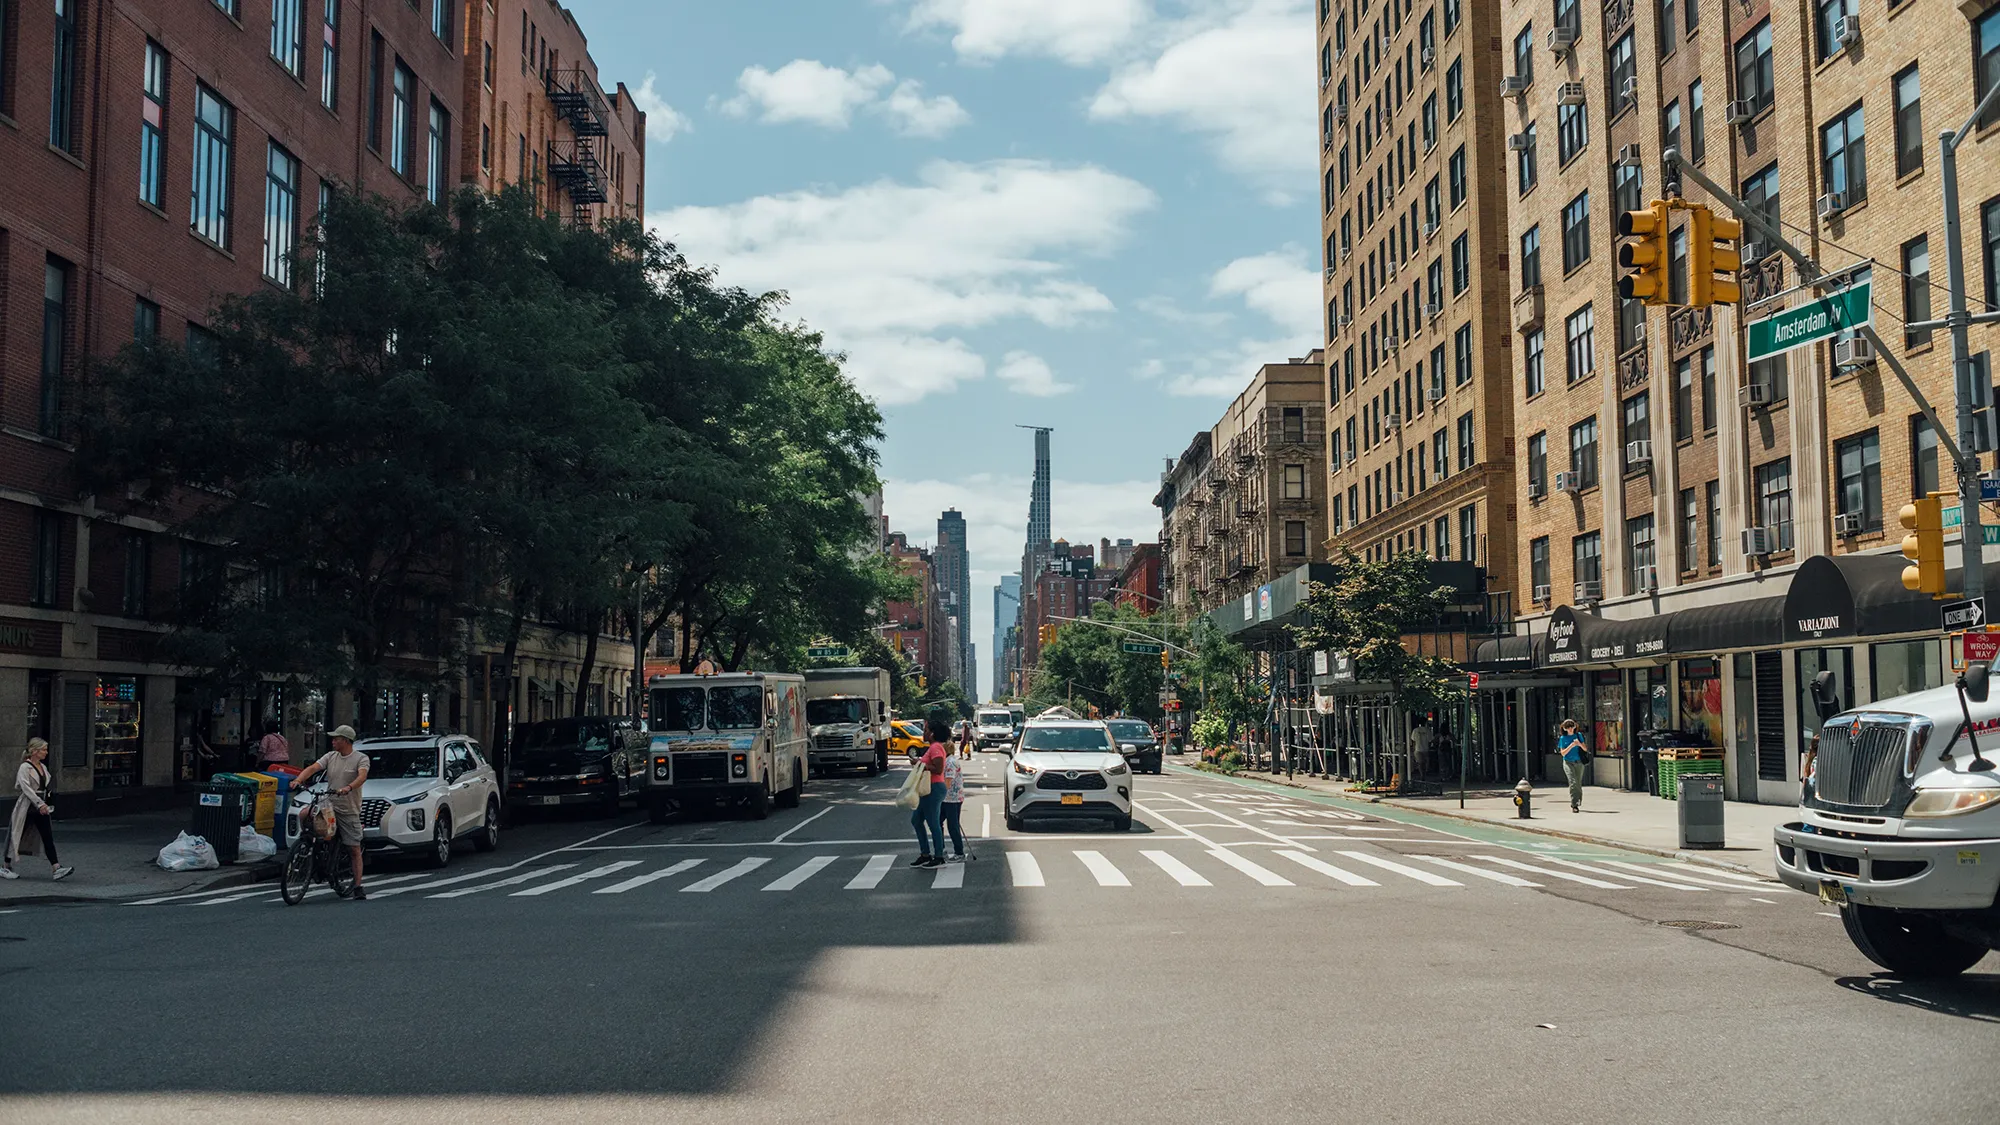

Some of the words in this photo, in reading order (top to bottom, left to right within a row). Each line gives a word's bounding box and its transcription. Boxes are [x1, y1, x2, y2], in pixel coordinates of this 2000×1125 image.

[1774, 311, 1827, 343] Amsterdam
[1829, 303, 1842, 326] Av
[1985, 527, 1998, 542] W
[1948, 611, 1961, 623] ONE
[1965, 607, 1979, 621] WAY
[1550, 621, 1560, 642] Key
[1560, 620, 1574, 637] Food
[1798, 615, 1840, 632] VARIAZIONI
[0, 624, 36, 648] NUTS
[1591, 646, 1611, 659] GROCERY
[1614, 645, 1624, 656] DELI
[1970, 642, 1997, 650] WRONG
[1549, 651, 1578, 662] SUPERMARKETS
[1975, 650, 1992, 658] WAY
